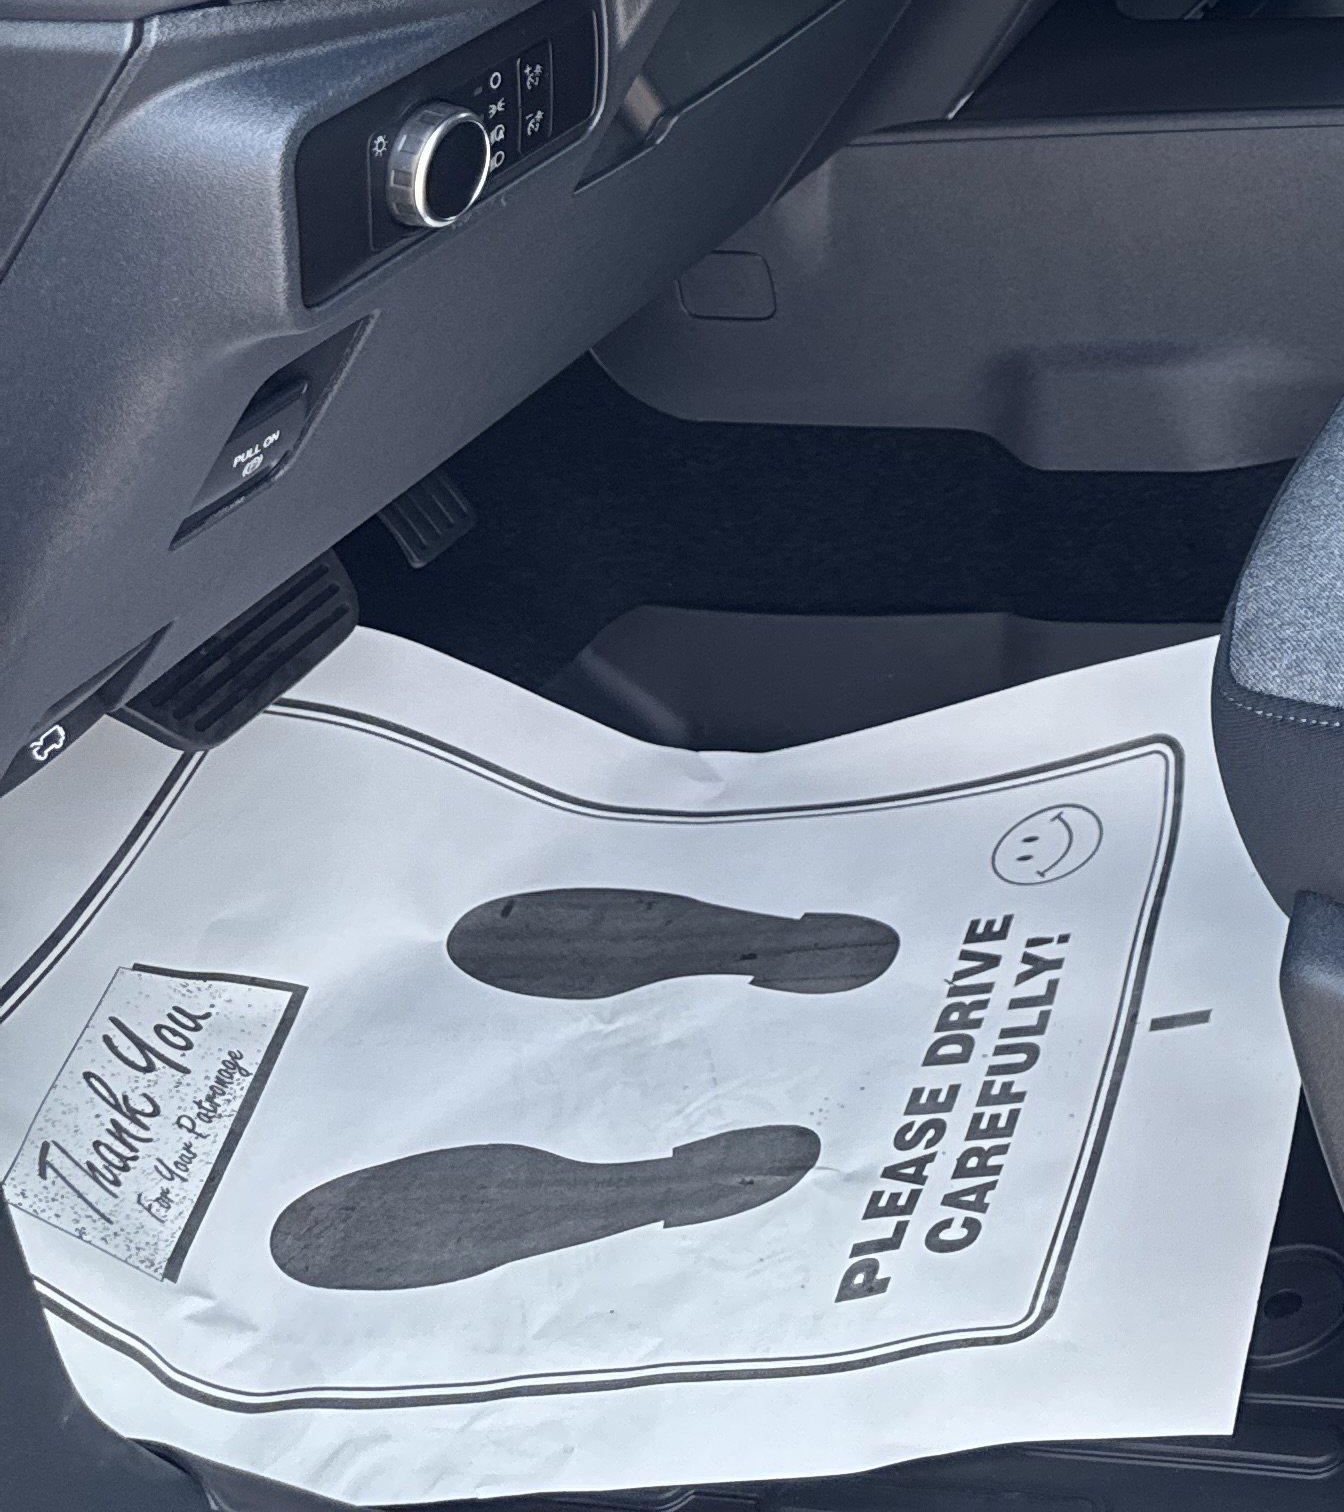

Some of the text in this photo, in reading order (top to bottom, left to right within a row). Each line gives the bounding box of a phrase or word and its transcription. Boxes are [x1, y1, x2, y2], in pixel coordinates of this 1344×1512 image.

[232, 430, 280, 468] PULL ON
[38, 1071, 161, 1225] Thank
[137, 1049, 253, 1224] For Your Patronage
[835, 914, 1014, 1303] PLEASE DRIVE
[924, 933, 1071, 1253] CAREFULLY!
